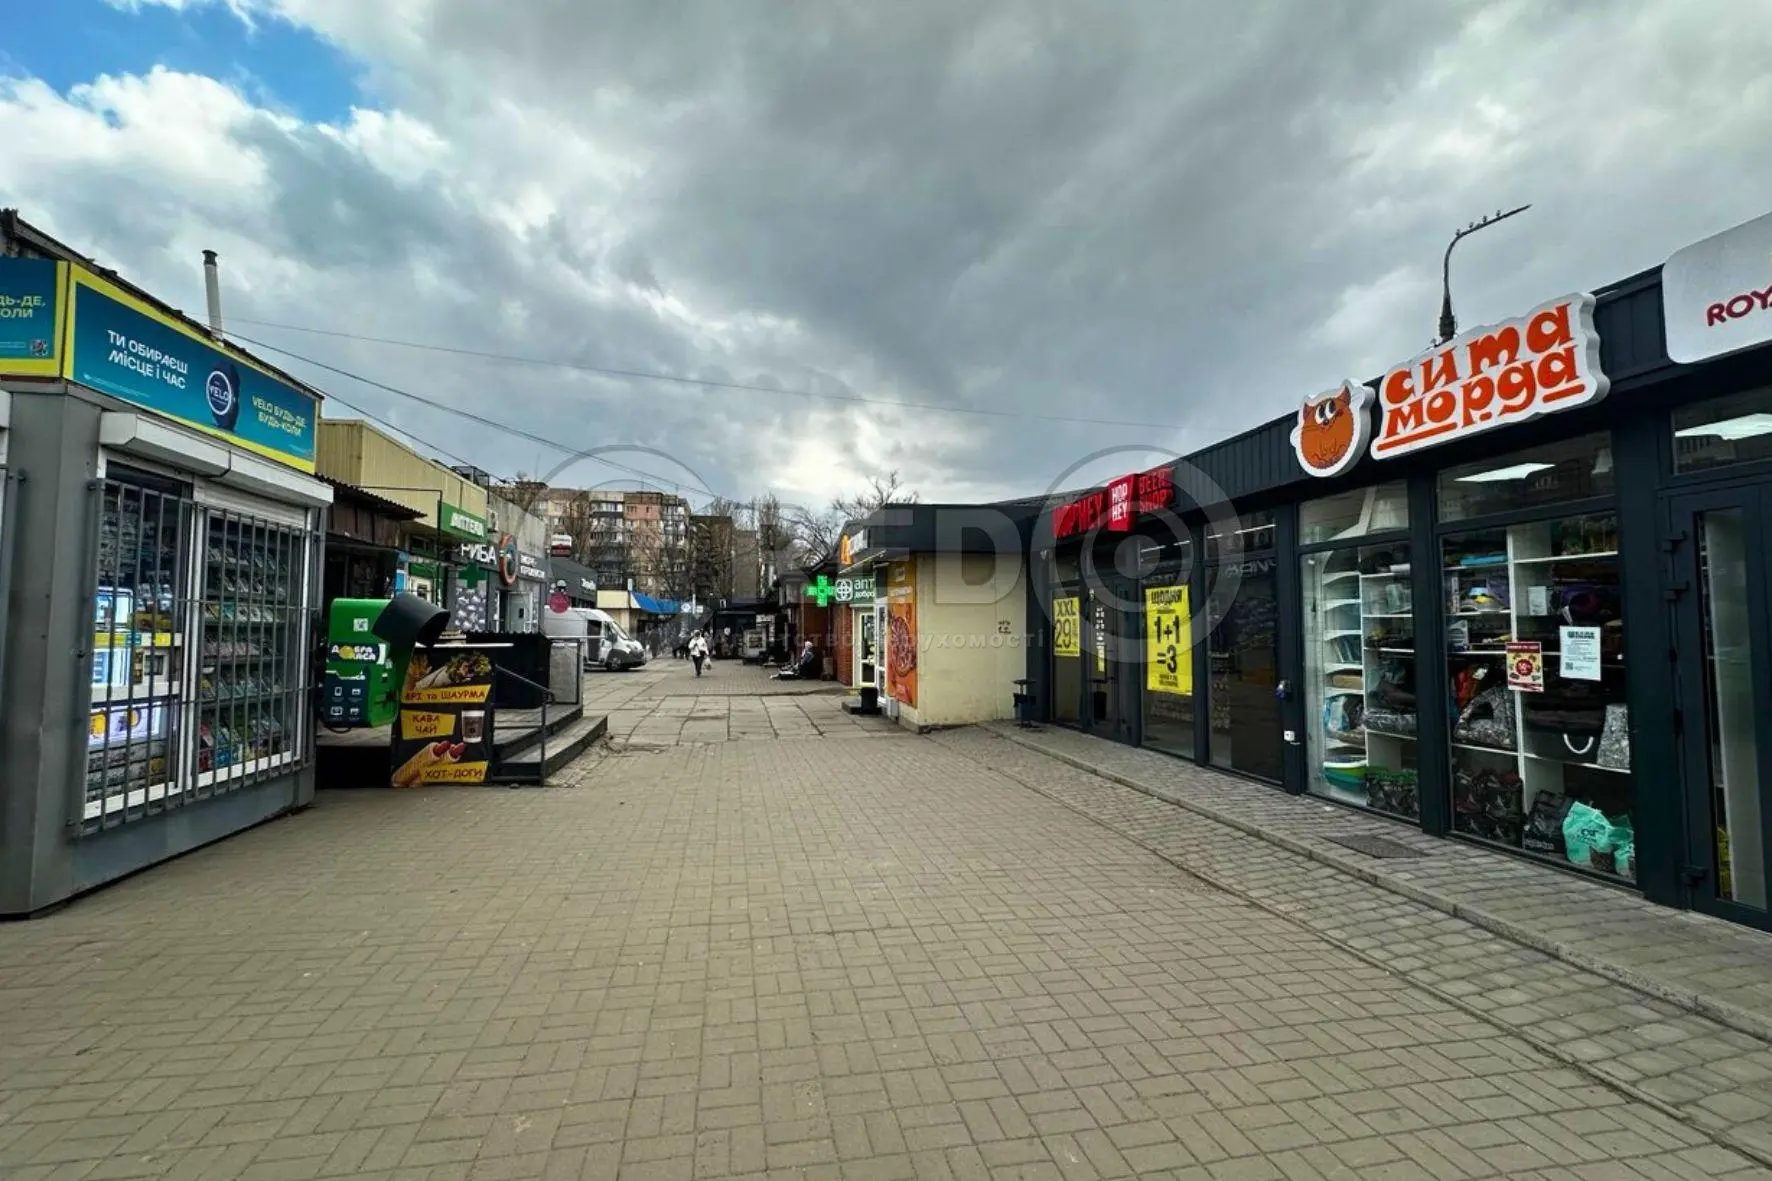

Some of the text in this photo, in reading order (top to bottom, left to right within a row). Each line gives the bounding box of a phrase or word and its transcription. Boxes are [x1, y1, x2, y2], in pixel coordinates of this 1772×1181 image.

[1706, 286, 1772, 327] ROY
[107, 329, 188, 374] ТИ ОБИРАЄШ
[162, 370, 186, 390] ЧАС
[1111, 483, 1128, 503] HOP
[1111, 501, 1128, 521] HEY
[1056, 600, 1076, 617] XXL
[1055, 618, 1072, 649] 29
[1154, 614, 1180, 644] 1+1
[1157, 644, 1177, 674] =3
[441, 690, 485, 699] ШАУРМА
